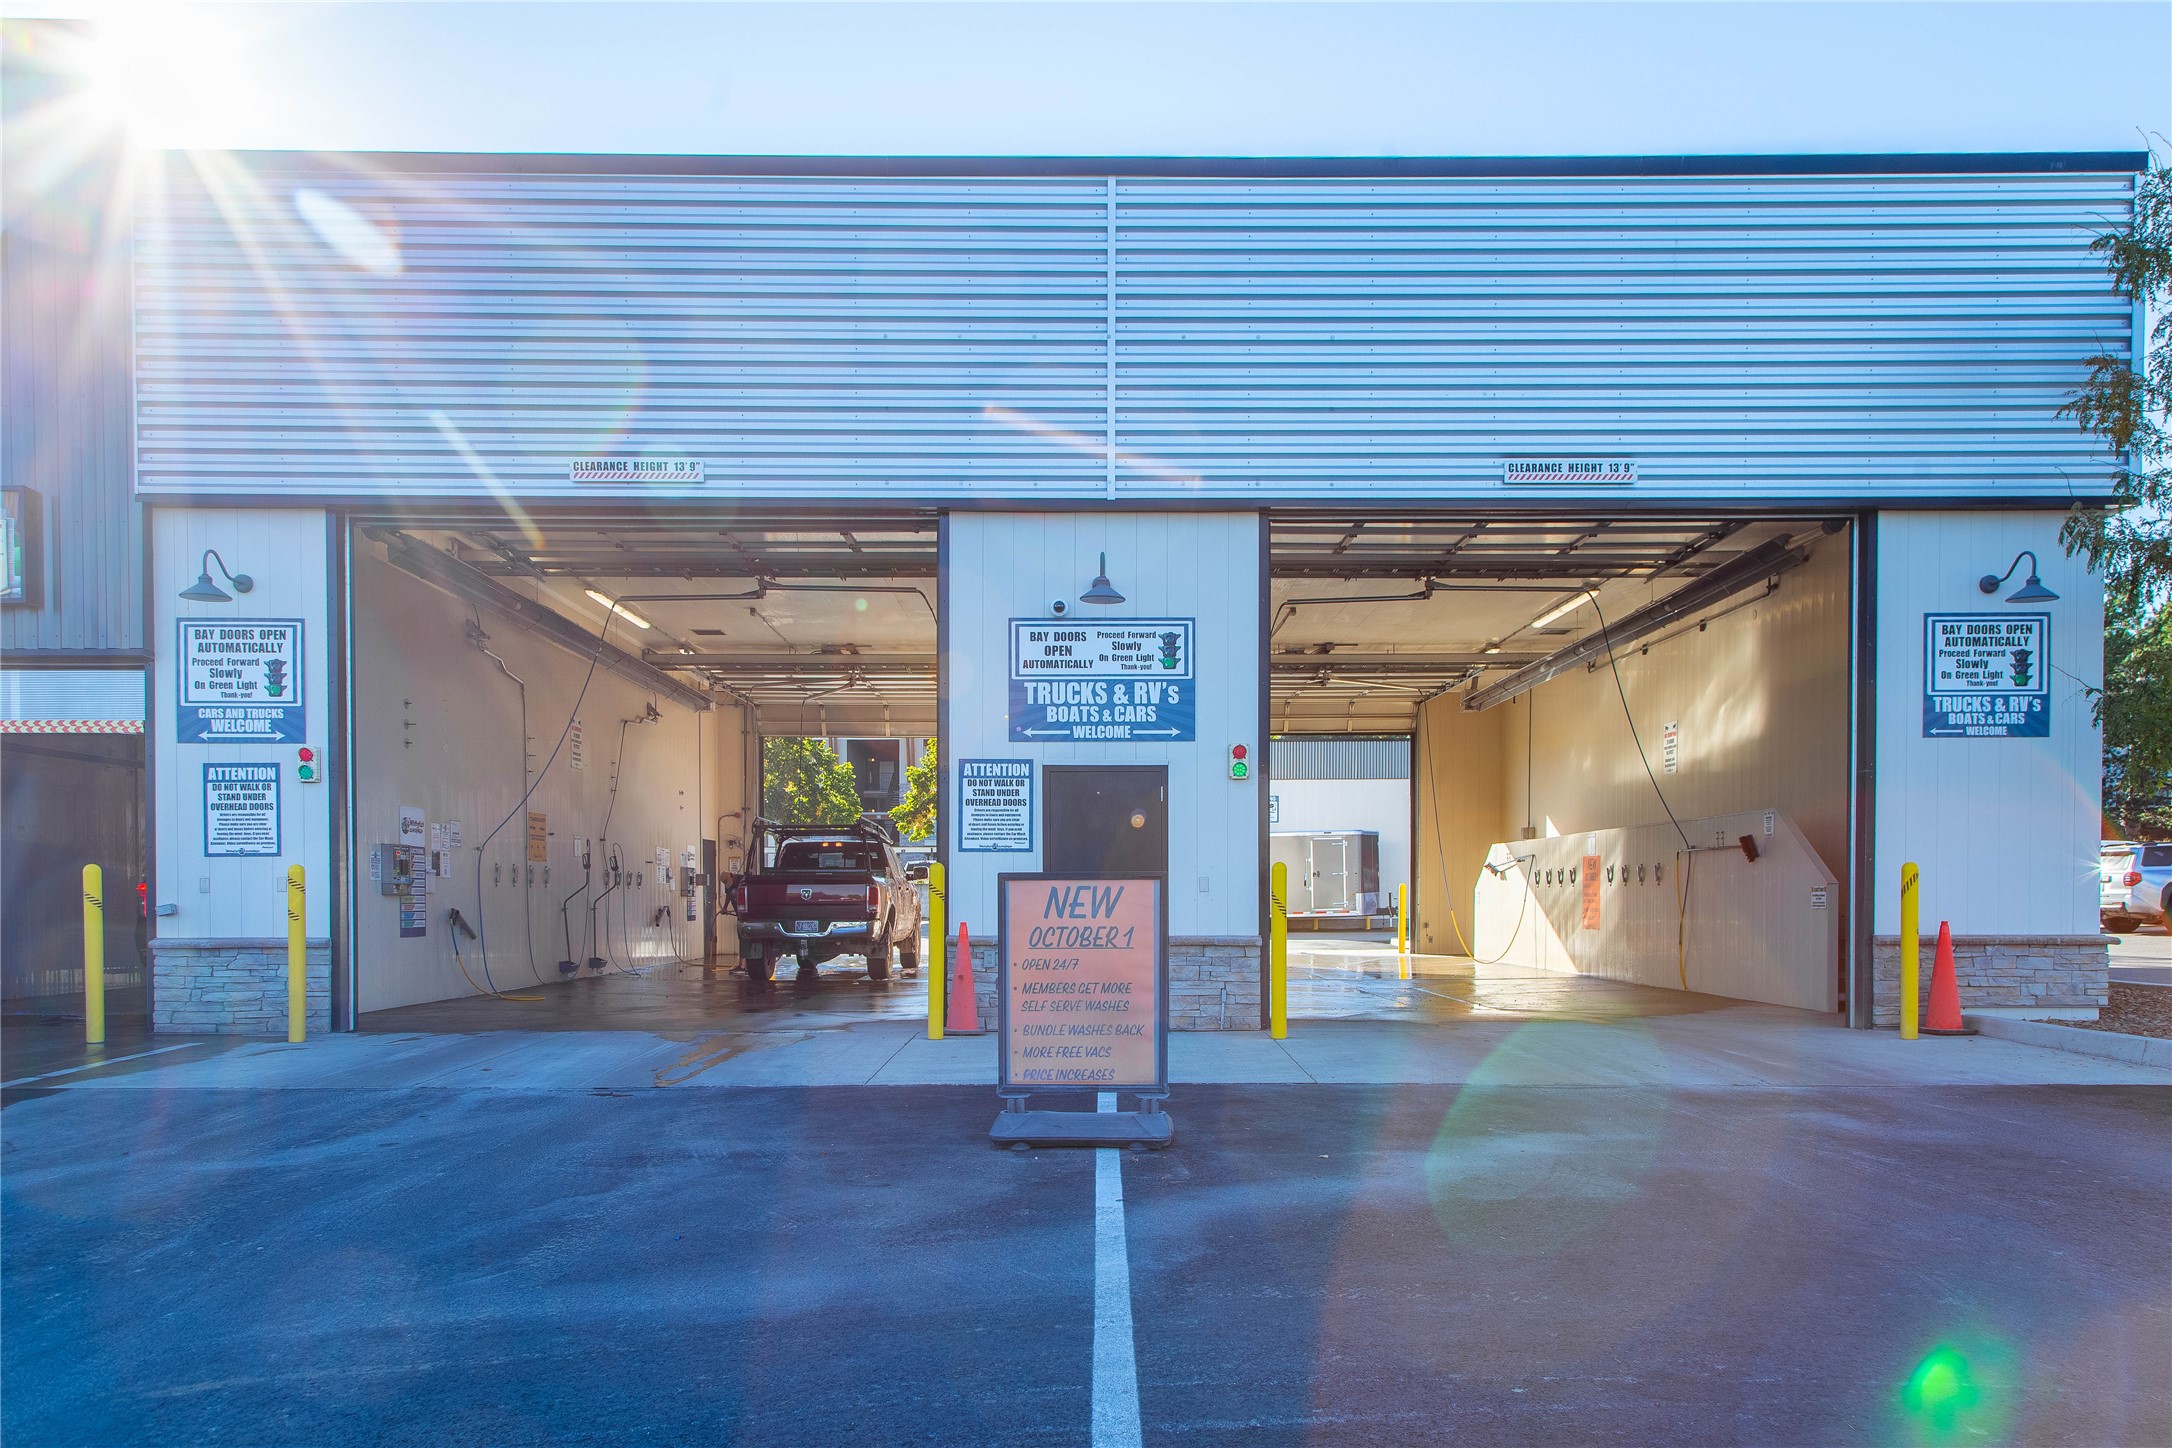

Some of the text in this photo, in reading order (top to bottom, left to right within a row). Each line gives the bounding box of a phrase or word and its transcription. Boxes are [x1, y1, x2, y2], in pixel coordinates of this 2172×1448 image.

[573, 462, 628, 471] CLEARANCE
[634, 462, 668, 471] HEIGHT
[1508, 463, 1562, 473] CLEARANCE
[1568, 463, 1603, 473] HEIGHT
[195, 629, 286, 640] BAY DOORS OPEN
[1942, 625, 2032, 635] BAY DOORS OPEN
[1030, 632, 1086, 642] BAY DOORS
[1945, 637, 2029, 647] AUTOMATICALLY
[198, 643, 283, 653] AUTOMATICALLY
[1044, 646, 1072, 656] OPEN
[1112, 642, 1142, 652] Slowly
[192, 658, 259, 666] Proceed Forward
[1099, 654, 1154, 662] On Green Light
[1023, 660, 1093, 669] AUTOMATICALLY
[1956, 659, 1988, 669] Slowly
[210, 668, 242, 679] Slowly
[1941, 671, 2003, 679] On Green Light
[195, 681, 258, 690] On Green Light
[1024, 682, 1179, 704] TRUCKS & RV's
[1933, 697, 2041, 712] TRUCKS & RV's
[199, 709, 284, 718] CARS AND TRUCKS
[1046, 706, 1156, 722] BOATS & CARS
[1948, 713, 2025, 724] BOATS & CARS
[211, 720, 271, 732] WELCOME
[1966, 727, 2007, 736] WELCOME
[1073, 726, 1131, 738] WELCOME
[208, 767, 276, 780] ATTENTION
[964, 764, 1029, 776] ATTENTION
[1044, 885, 1125, 919] NEW
[1029, 926, 1135, 948] OCTOBER 1
[1022, 959, 1079, 970] OPEN 24/7
[1022, 983, 1132, 994] MEMBERS GET MORE
[1021, 1000, 1129, 1012] SELF SERVE WASHES
[1023, 1024, 1145, 1036] BUNDLE WASHES BACK
[1023, 1047, 1112, 1058] MORE FREE VACS
[1023, 1069, 1115, 1080] PRICE INCREASES
